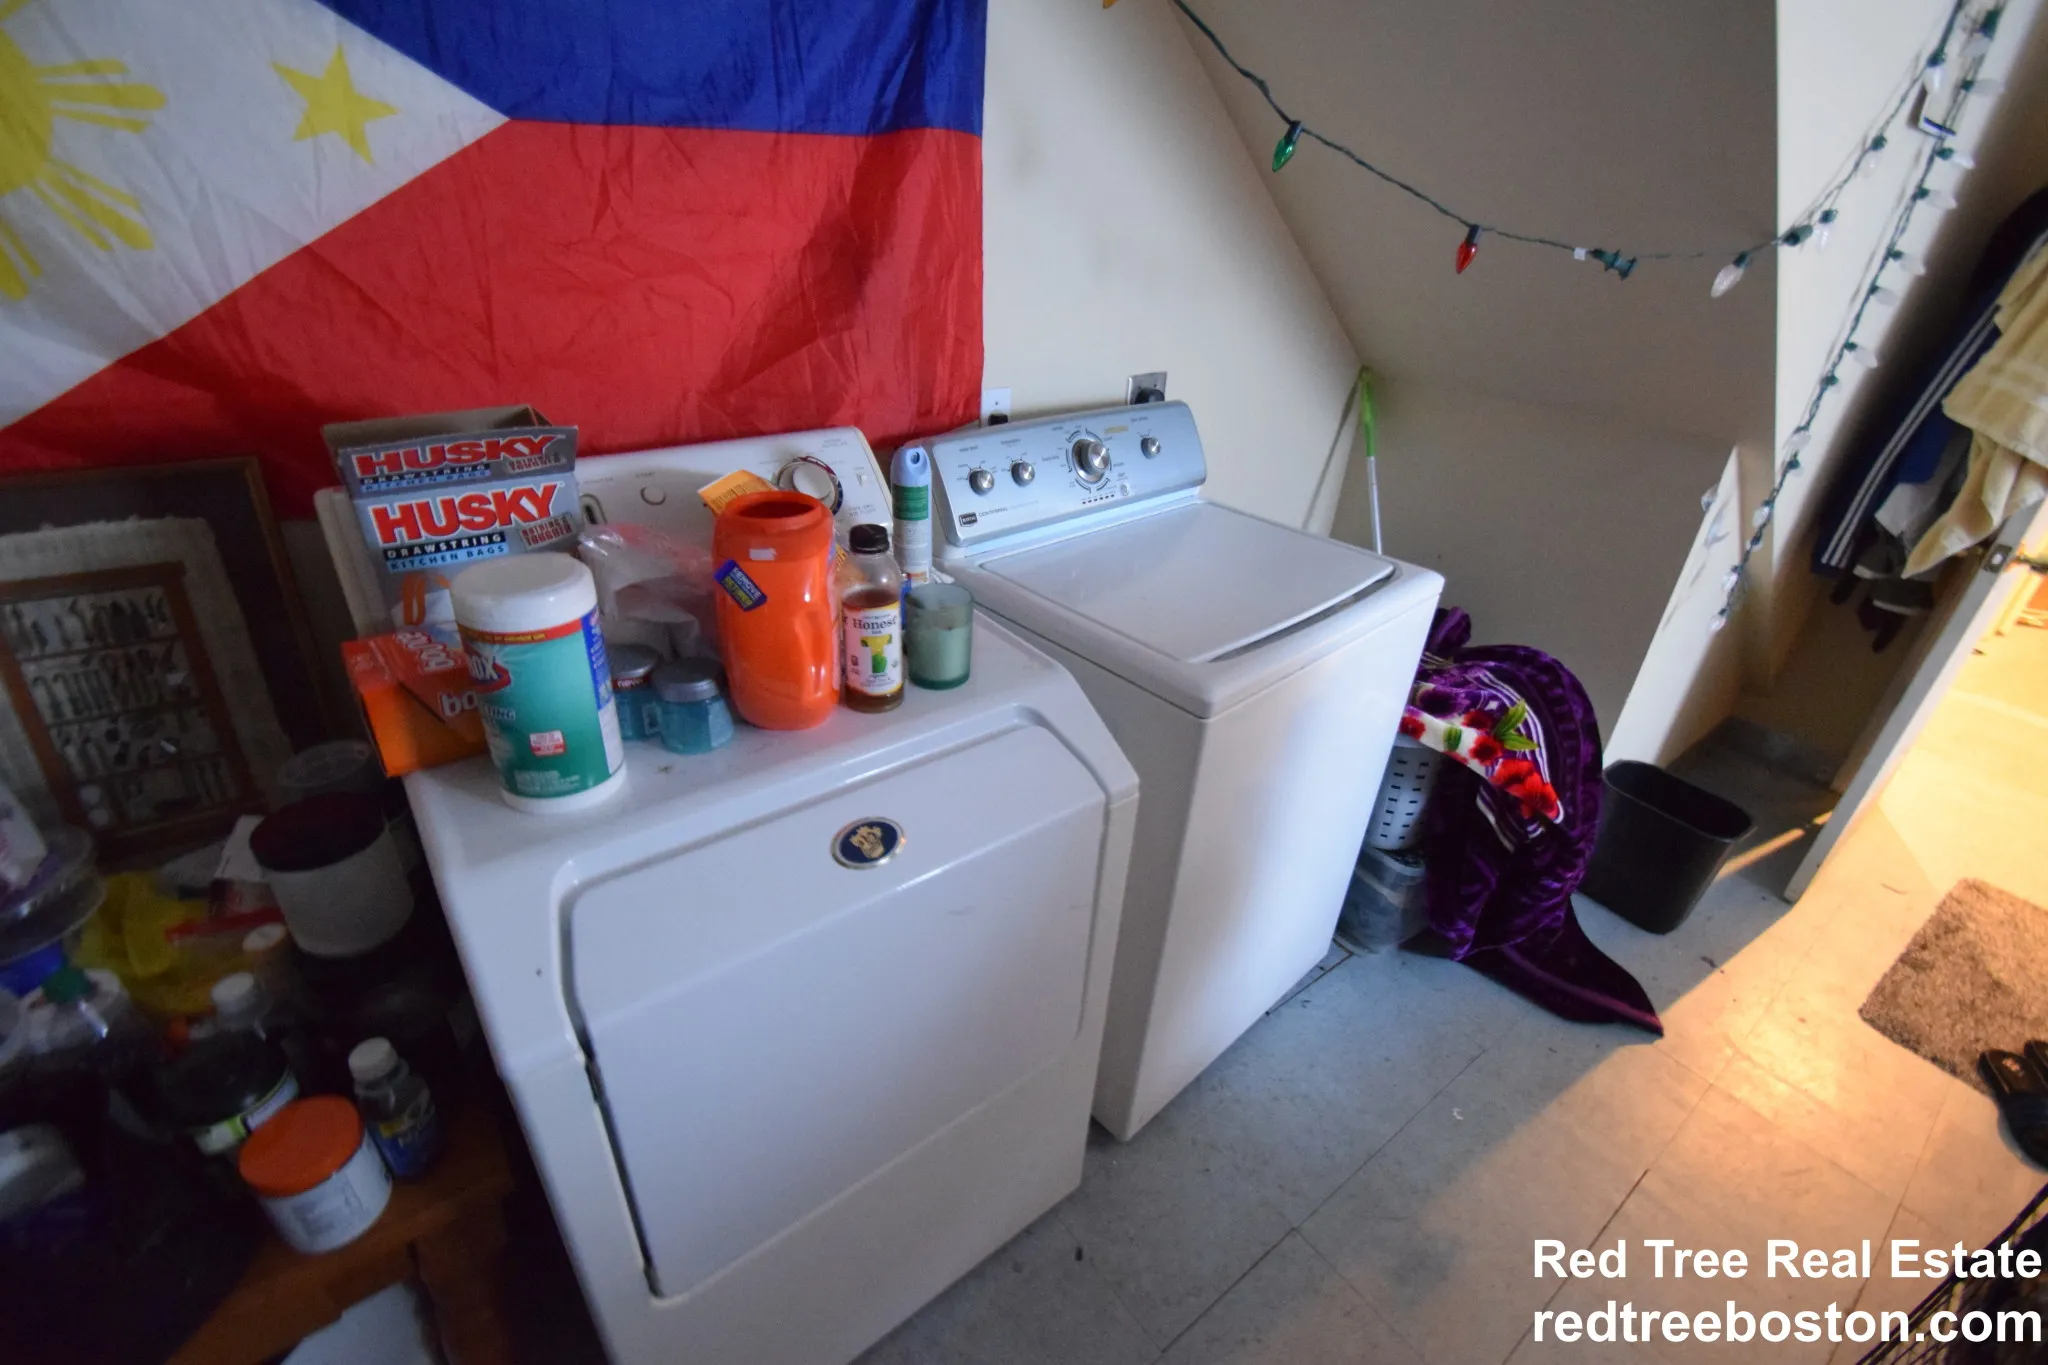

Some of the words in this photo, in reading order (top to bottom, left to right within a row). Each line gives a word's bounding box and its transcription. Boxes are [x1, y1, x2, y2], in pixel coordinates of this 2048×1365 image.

[353, 435, 556, 477] HUSKY
[370, 484, 557, 545] HUSKY
[387, 534, 502, 558] DRAWSTRING
[390, 553, 459, 571] KITCHEN
[467, 545, 505, 558] BAGS
[852, 615, 897, 629] Honest
